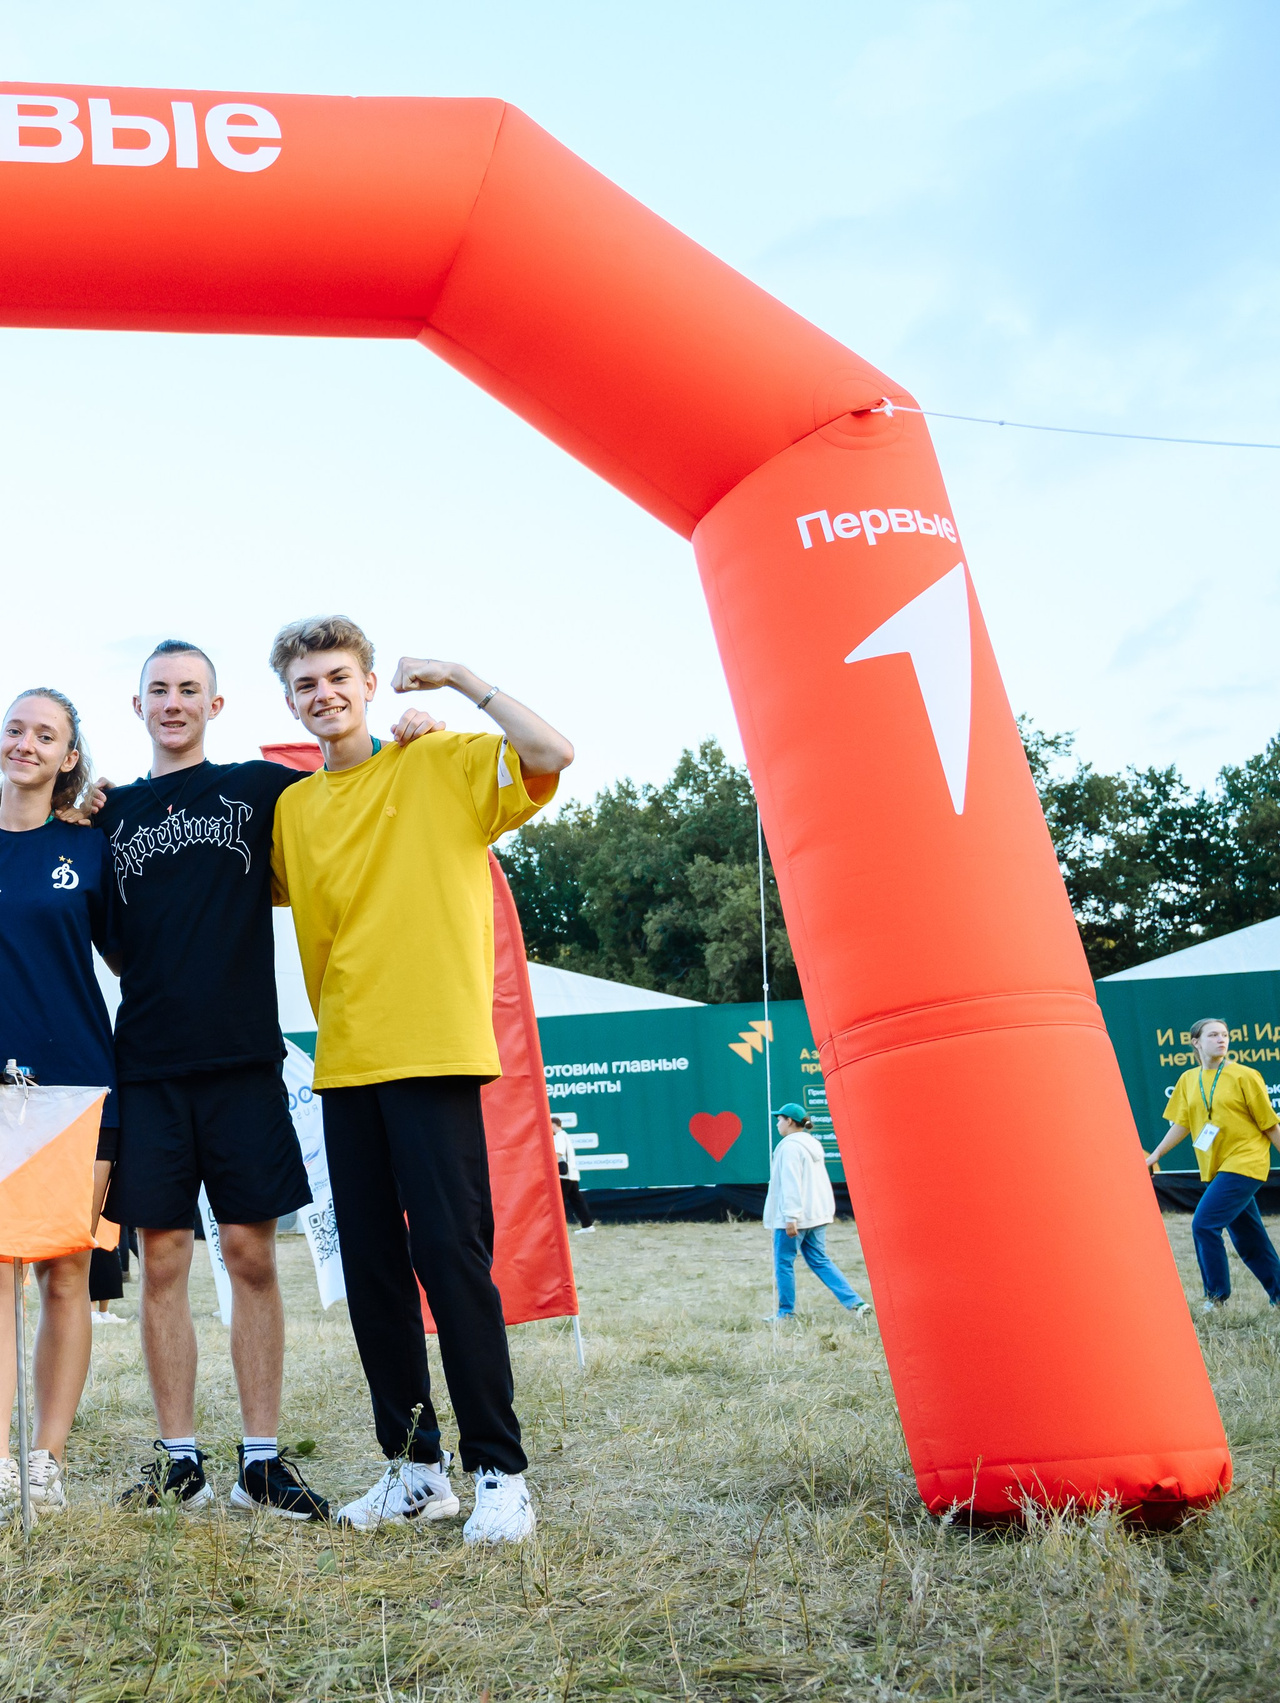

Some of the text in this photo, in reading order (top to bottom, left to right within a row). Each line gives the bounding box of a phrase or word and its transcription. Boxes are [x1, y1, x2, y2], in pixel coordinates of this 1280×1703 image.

[796, 508, 957, 550] Первые
[1156, 1028, 1174, 1047] И
[1226, 1047, 1280, 1063] окин
[544, 1057, 689, 1078] отовим главные
[546, 1080, 621, 1098] едиенты
